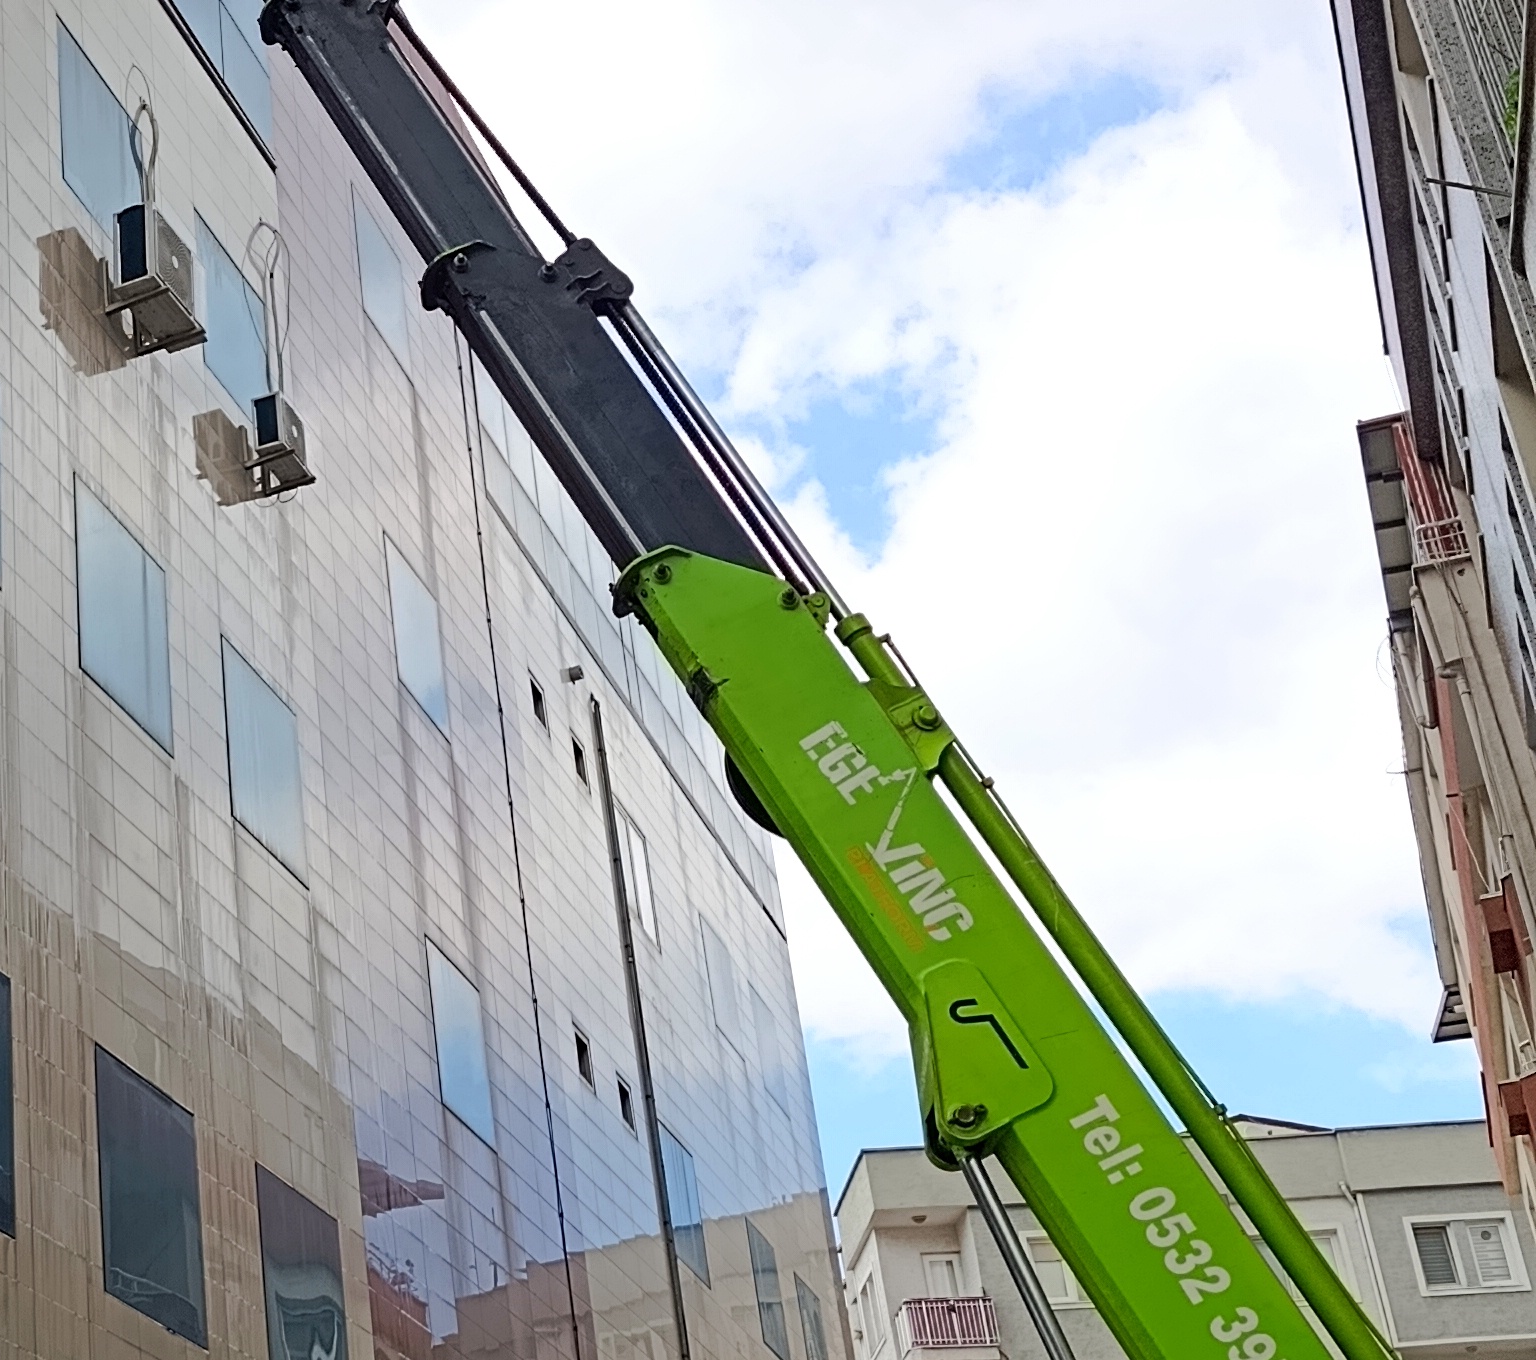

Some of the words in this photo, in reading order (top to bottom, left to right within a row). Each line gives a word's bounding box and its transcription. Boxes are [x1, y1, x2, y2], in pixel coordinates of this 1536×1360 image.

[798, 720, 882, 806] EGE
[1069, 1093, 1144, 1186] Tel:
[1128, 1186, 1232, 1306] 0532
